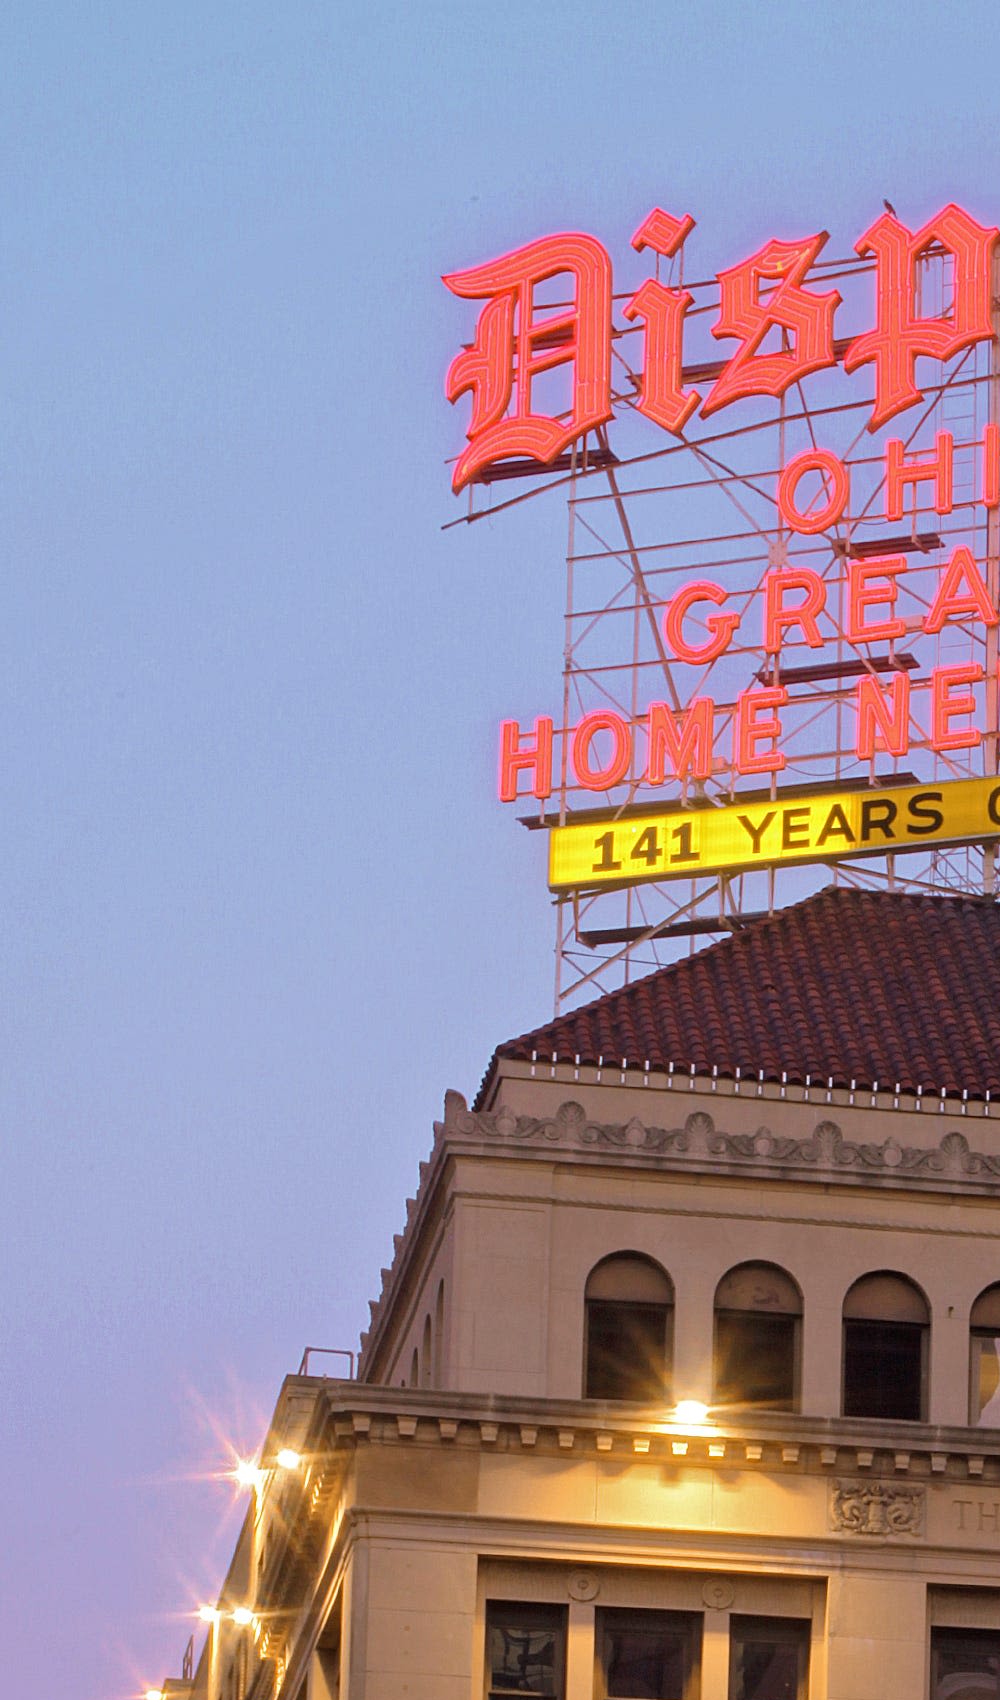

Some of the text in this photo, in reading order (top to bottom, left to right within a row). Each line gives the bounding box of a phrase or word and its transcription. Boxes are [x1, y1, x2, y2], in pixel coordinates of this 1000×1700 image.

[499, 685, 788, 802] HOME
[592, 822, 700, 872] 141
[737, 793, 944, 853] YEARS
